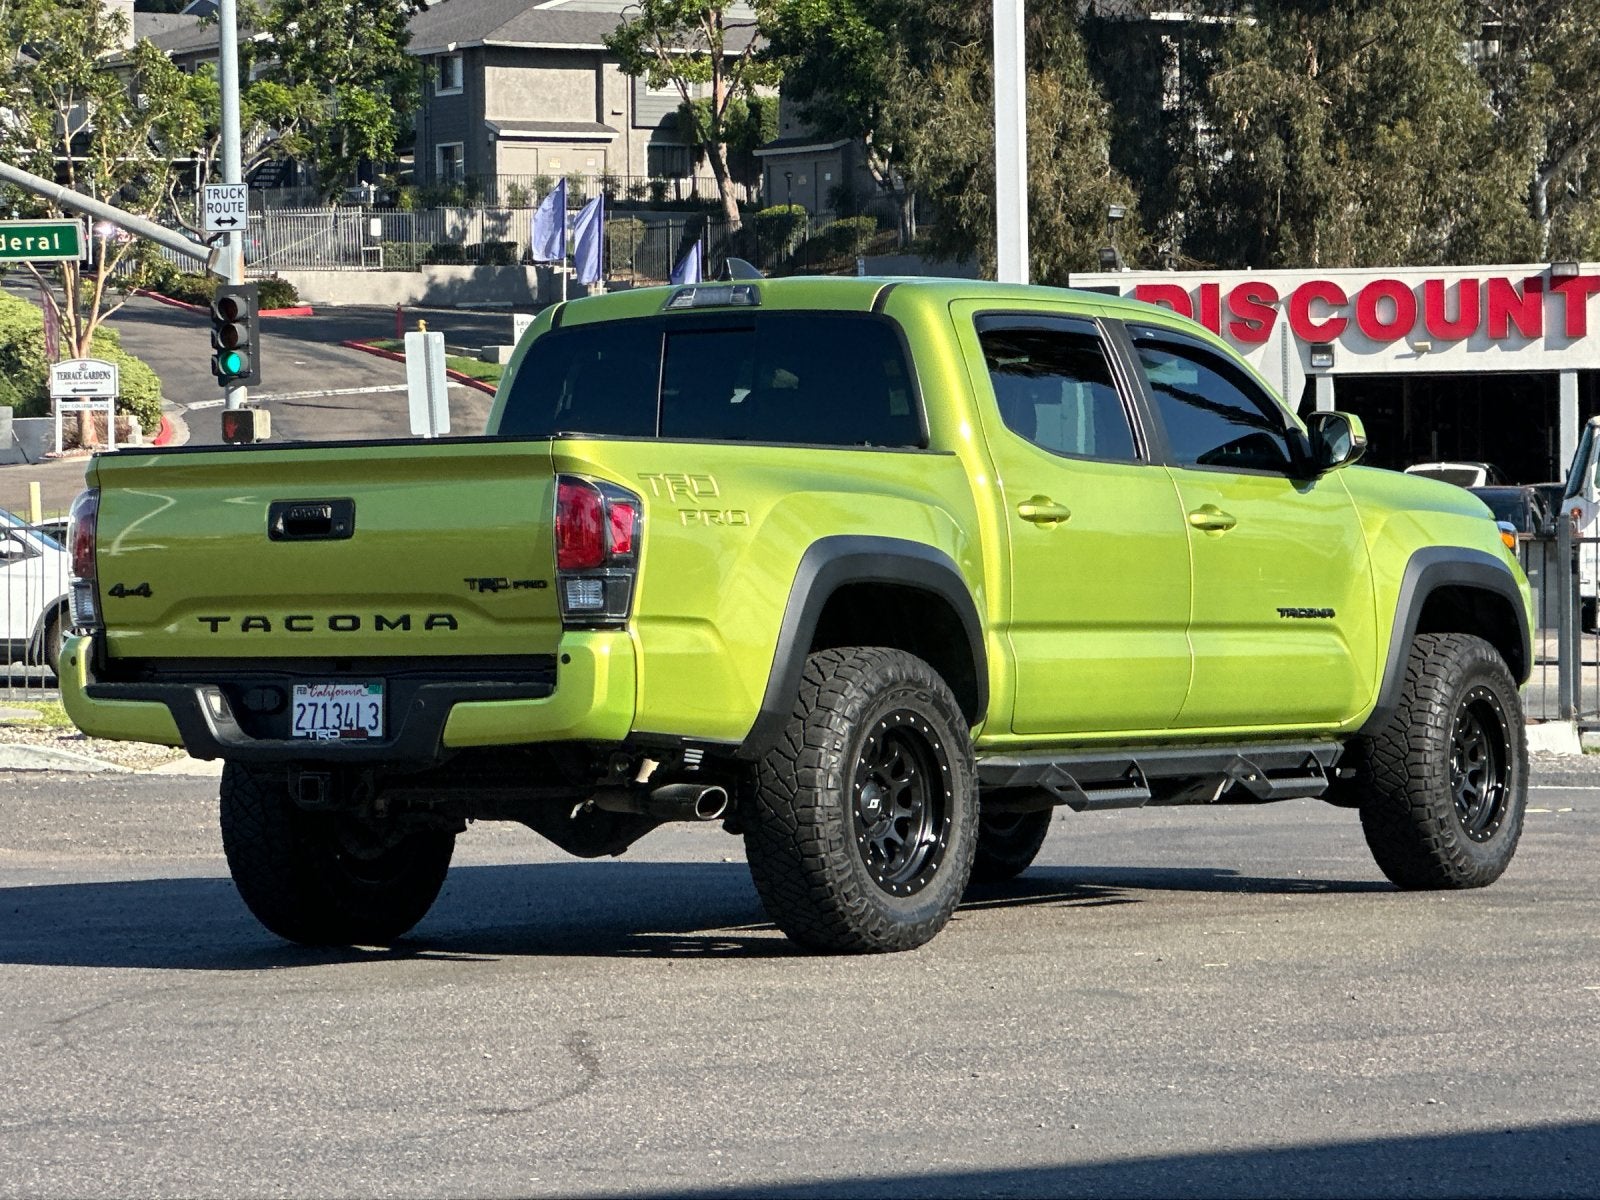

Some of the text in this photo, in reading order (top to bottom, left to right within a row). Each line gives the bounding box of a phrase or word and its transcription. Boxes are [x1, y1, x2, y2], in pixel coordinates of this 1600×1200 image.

[206, 188, 245, 200] TRUCK
[206, 202, 245, 214] ROUTE
[56, 370, 111, 380] TERRACE GARDENS
[637, 472, 720, 503] TRD
[678, 508, 750, 527] PRO
[463, 577, 548, 593] TRD PRO
[1276, 607, 1336, 619] TACOMA
[197, 613, 459, 633] TACOMA
[309, 682, 369, 701] California
[295, 701, 379, 731] 27134L3
[304, 728, 341, 741] TRD
